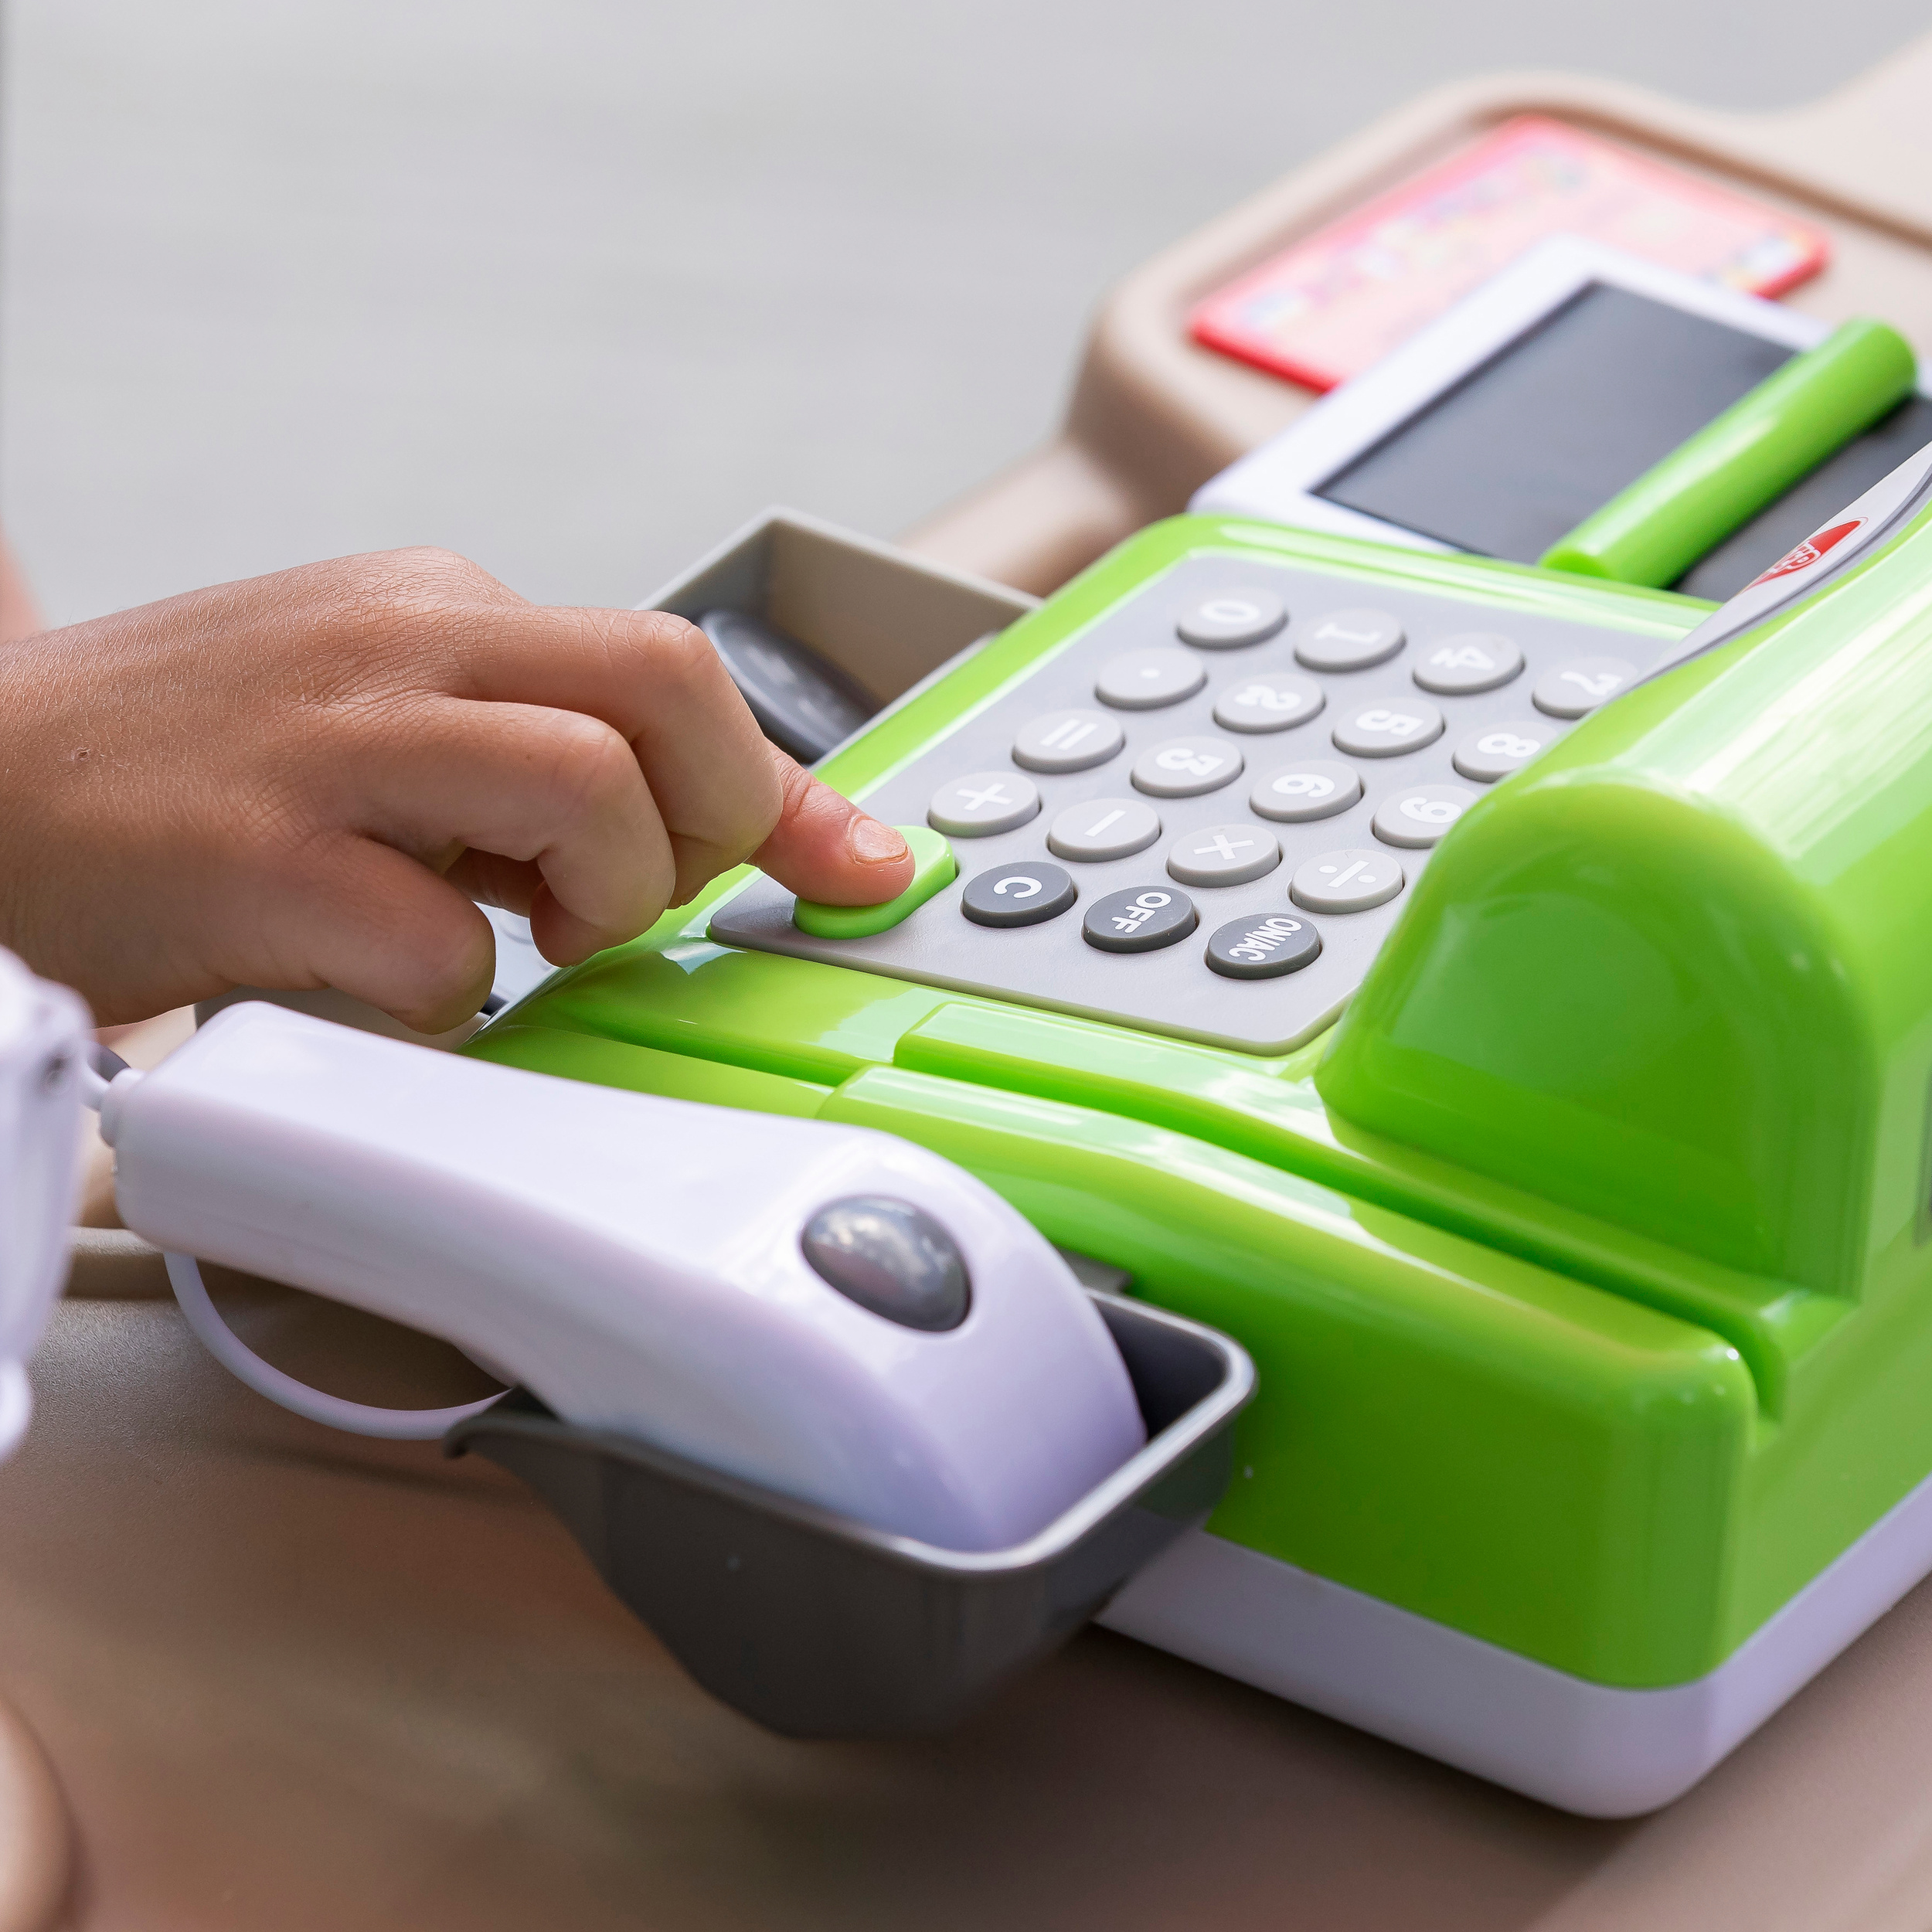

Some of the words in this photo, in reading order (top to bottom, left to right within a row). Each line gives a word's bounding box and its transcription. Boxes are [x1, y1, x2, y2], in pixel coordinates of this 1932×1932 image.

[1199, 599, 1261, 624] 0
[1315, 622, 1382, 644] 1
[1430, 645, 1495, 670] 4
[1560, 671, 1623, 696] 7
[1235, 685, 1301, 710] 2
[1355, 709, 1423, 736] 5
[1477, 733, 1541, 757] 8
[1155, 747, 1224, 777] 3
[1272, 773, 1335, 798] 6
[1400, 797, 1462, 823] 9
[993, 876, 1043, 898] C
[1111, 892, 1172, 934] OFF
[1228, 917, 1302, 961] ON/AC
